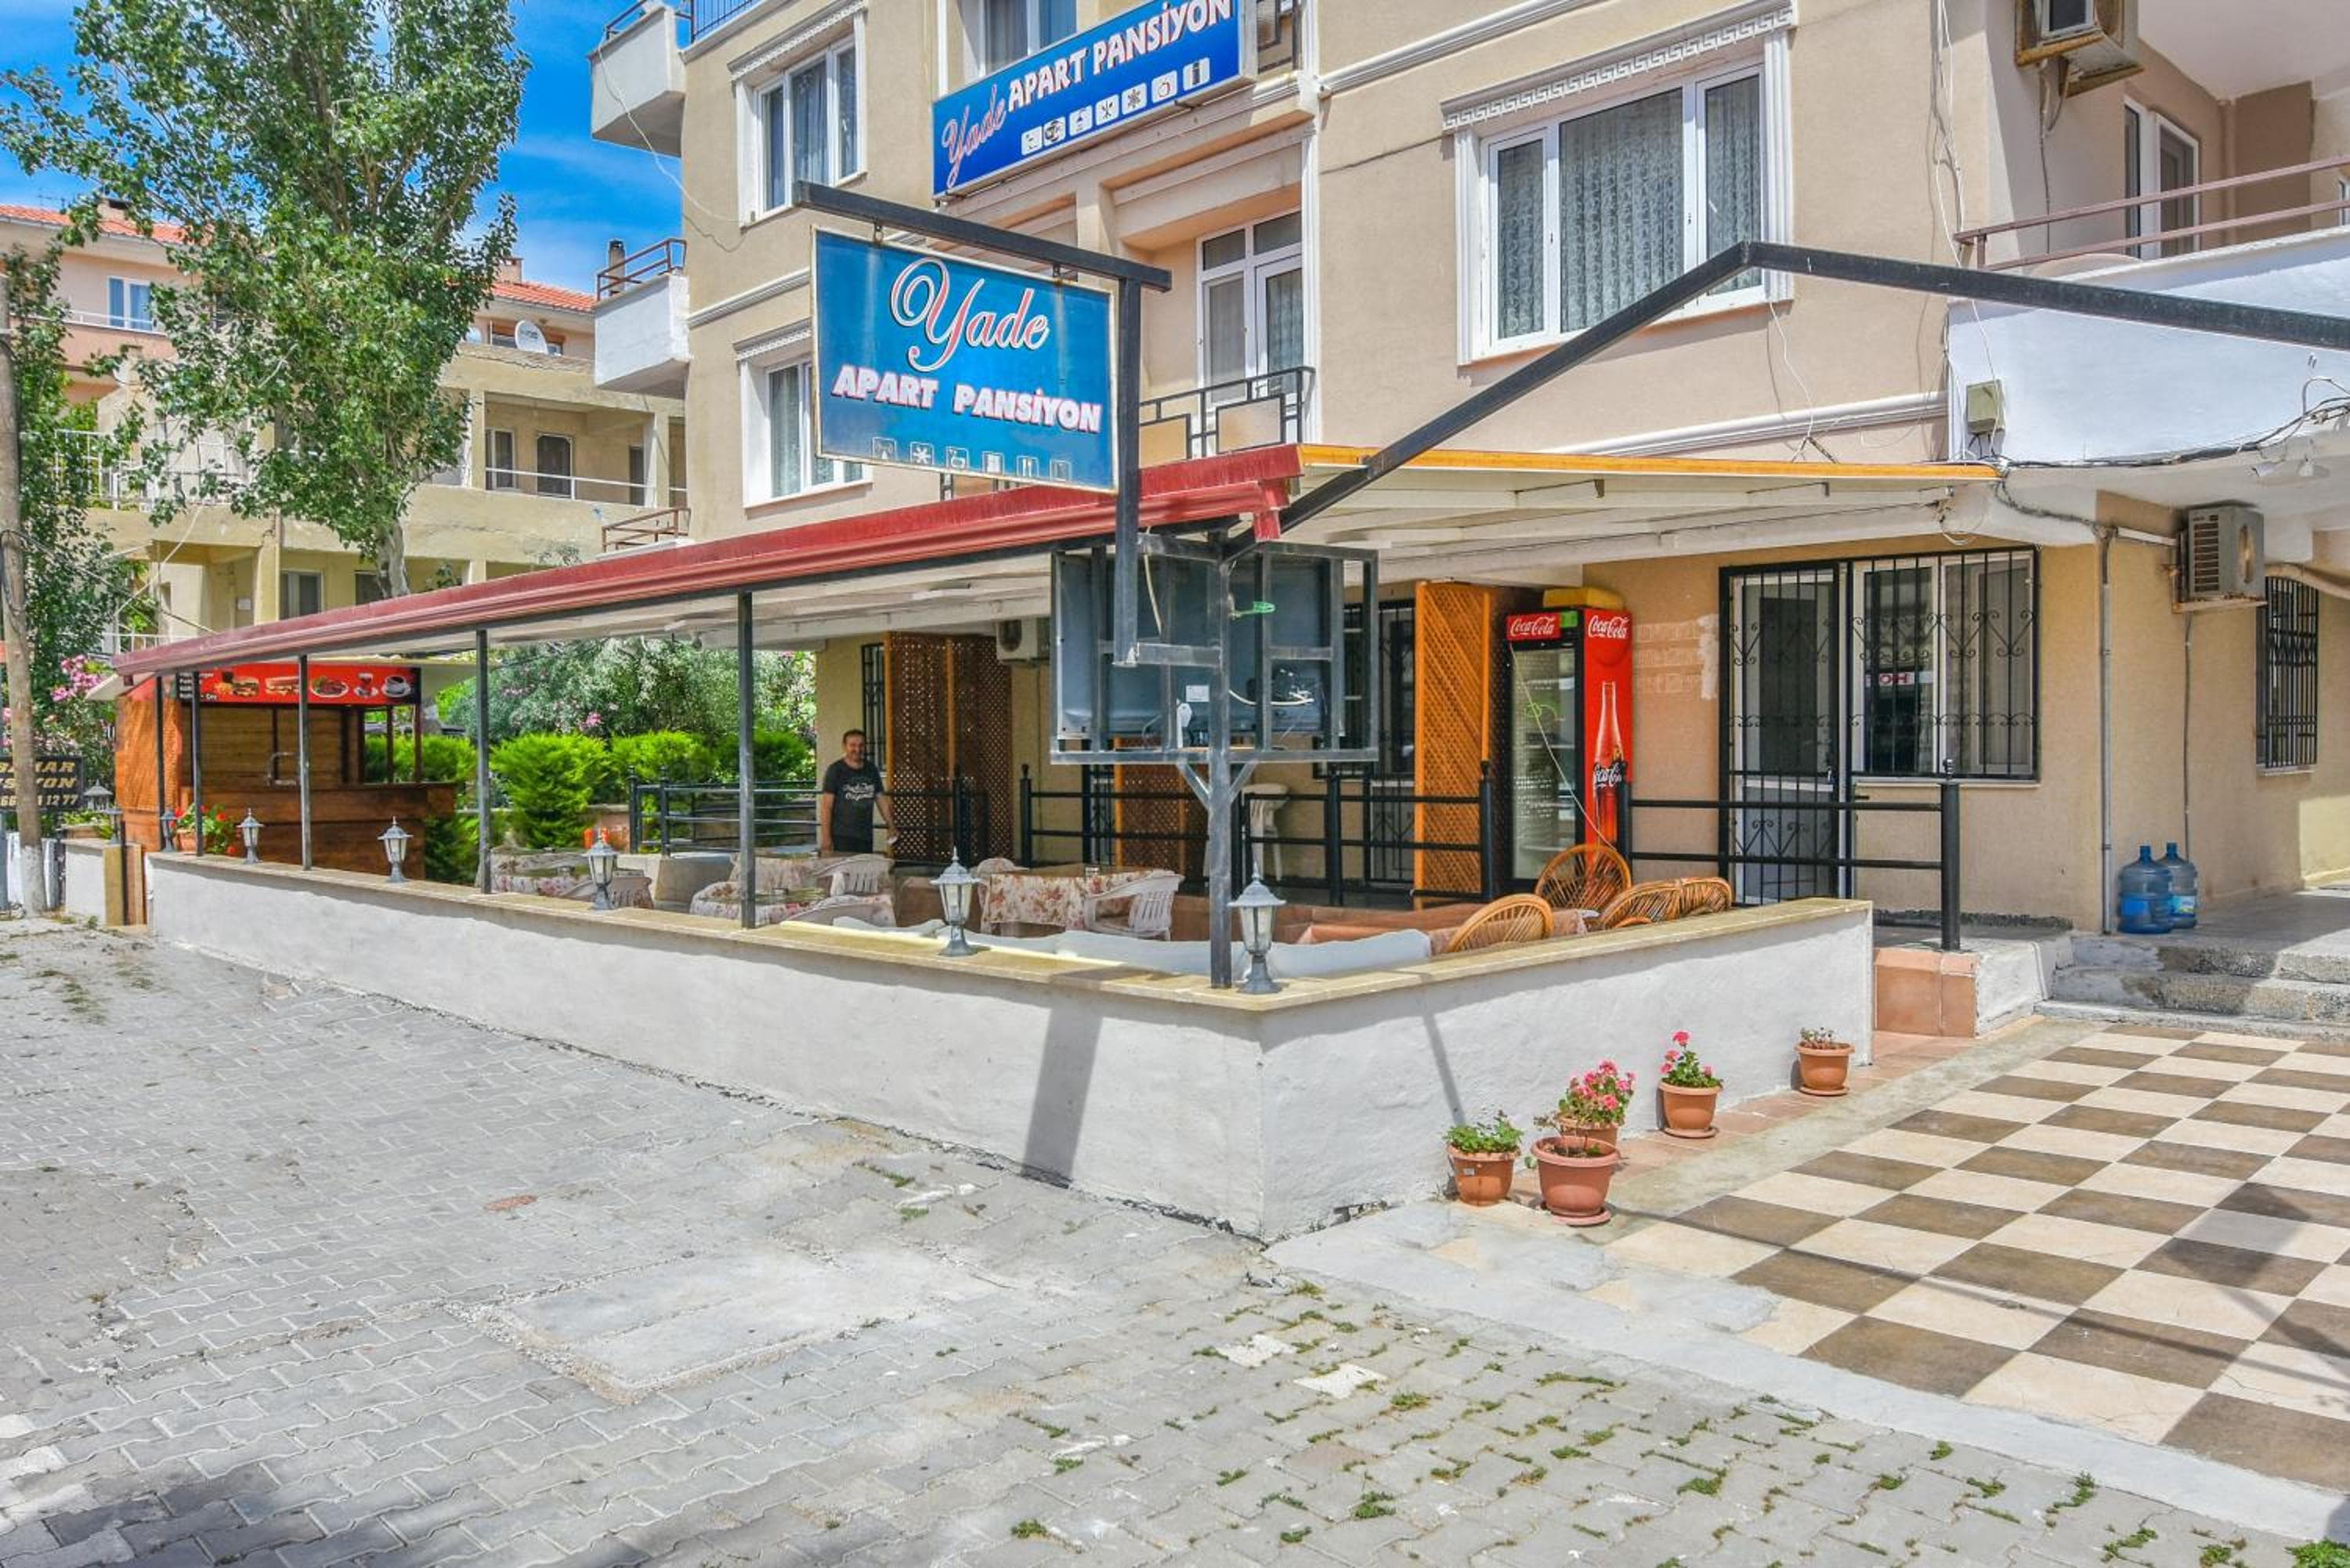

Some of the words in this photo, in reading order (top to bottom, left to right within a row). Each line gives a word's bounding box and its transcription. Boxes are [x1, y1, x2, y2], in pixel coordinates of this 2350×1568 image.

[942, 84, 1007, 188] Yade
[1008, 48, 1088, 112] APART
[891, 257, 1050, 372] Yade
[830, 365, 938, 408] APART
[953, 388, 1103, 433] PANSİYON
